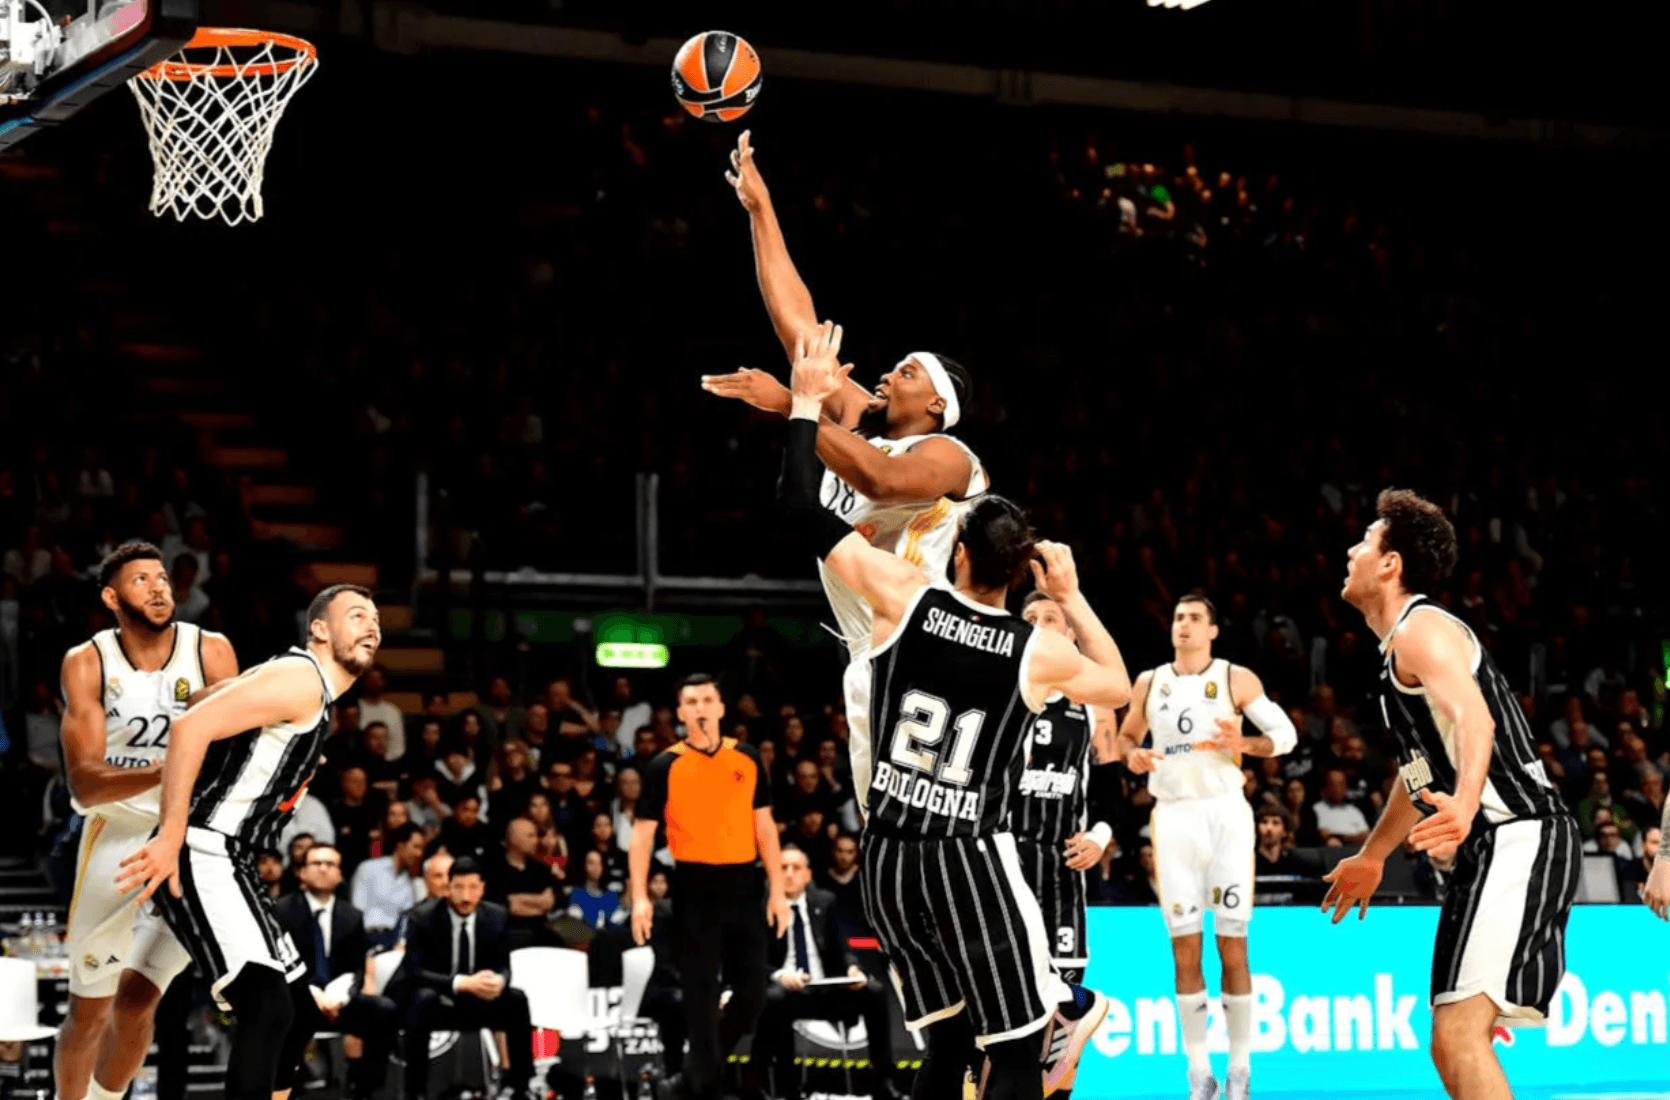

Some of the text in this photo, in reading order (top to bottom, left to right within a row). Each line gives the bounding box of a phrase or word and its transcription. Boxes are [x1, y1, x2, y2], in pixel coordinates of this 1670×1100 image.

[922, 606, 1015, 658] SHENGELIA
[126, 713, 171, 748] 22
[1034, 719, 1053, 745] 3
[1177, 706, 1193, 735] 6
[889, 688, 987, 787] 21
[871, 760, 979, 822] BOLOGNA
[1223, 883, 1240, 909] 6
[1057, 926, 1074, 953] 3
